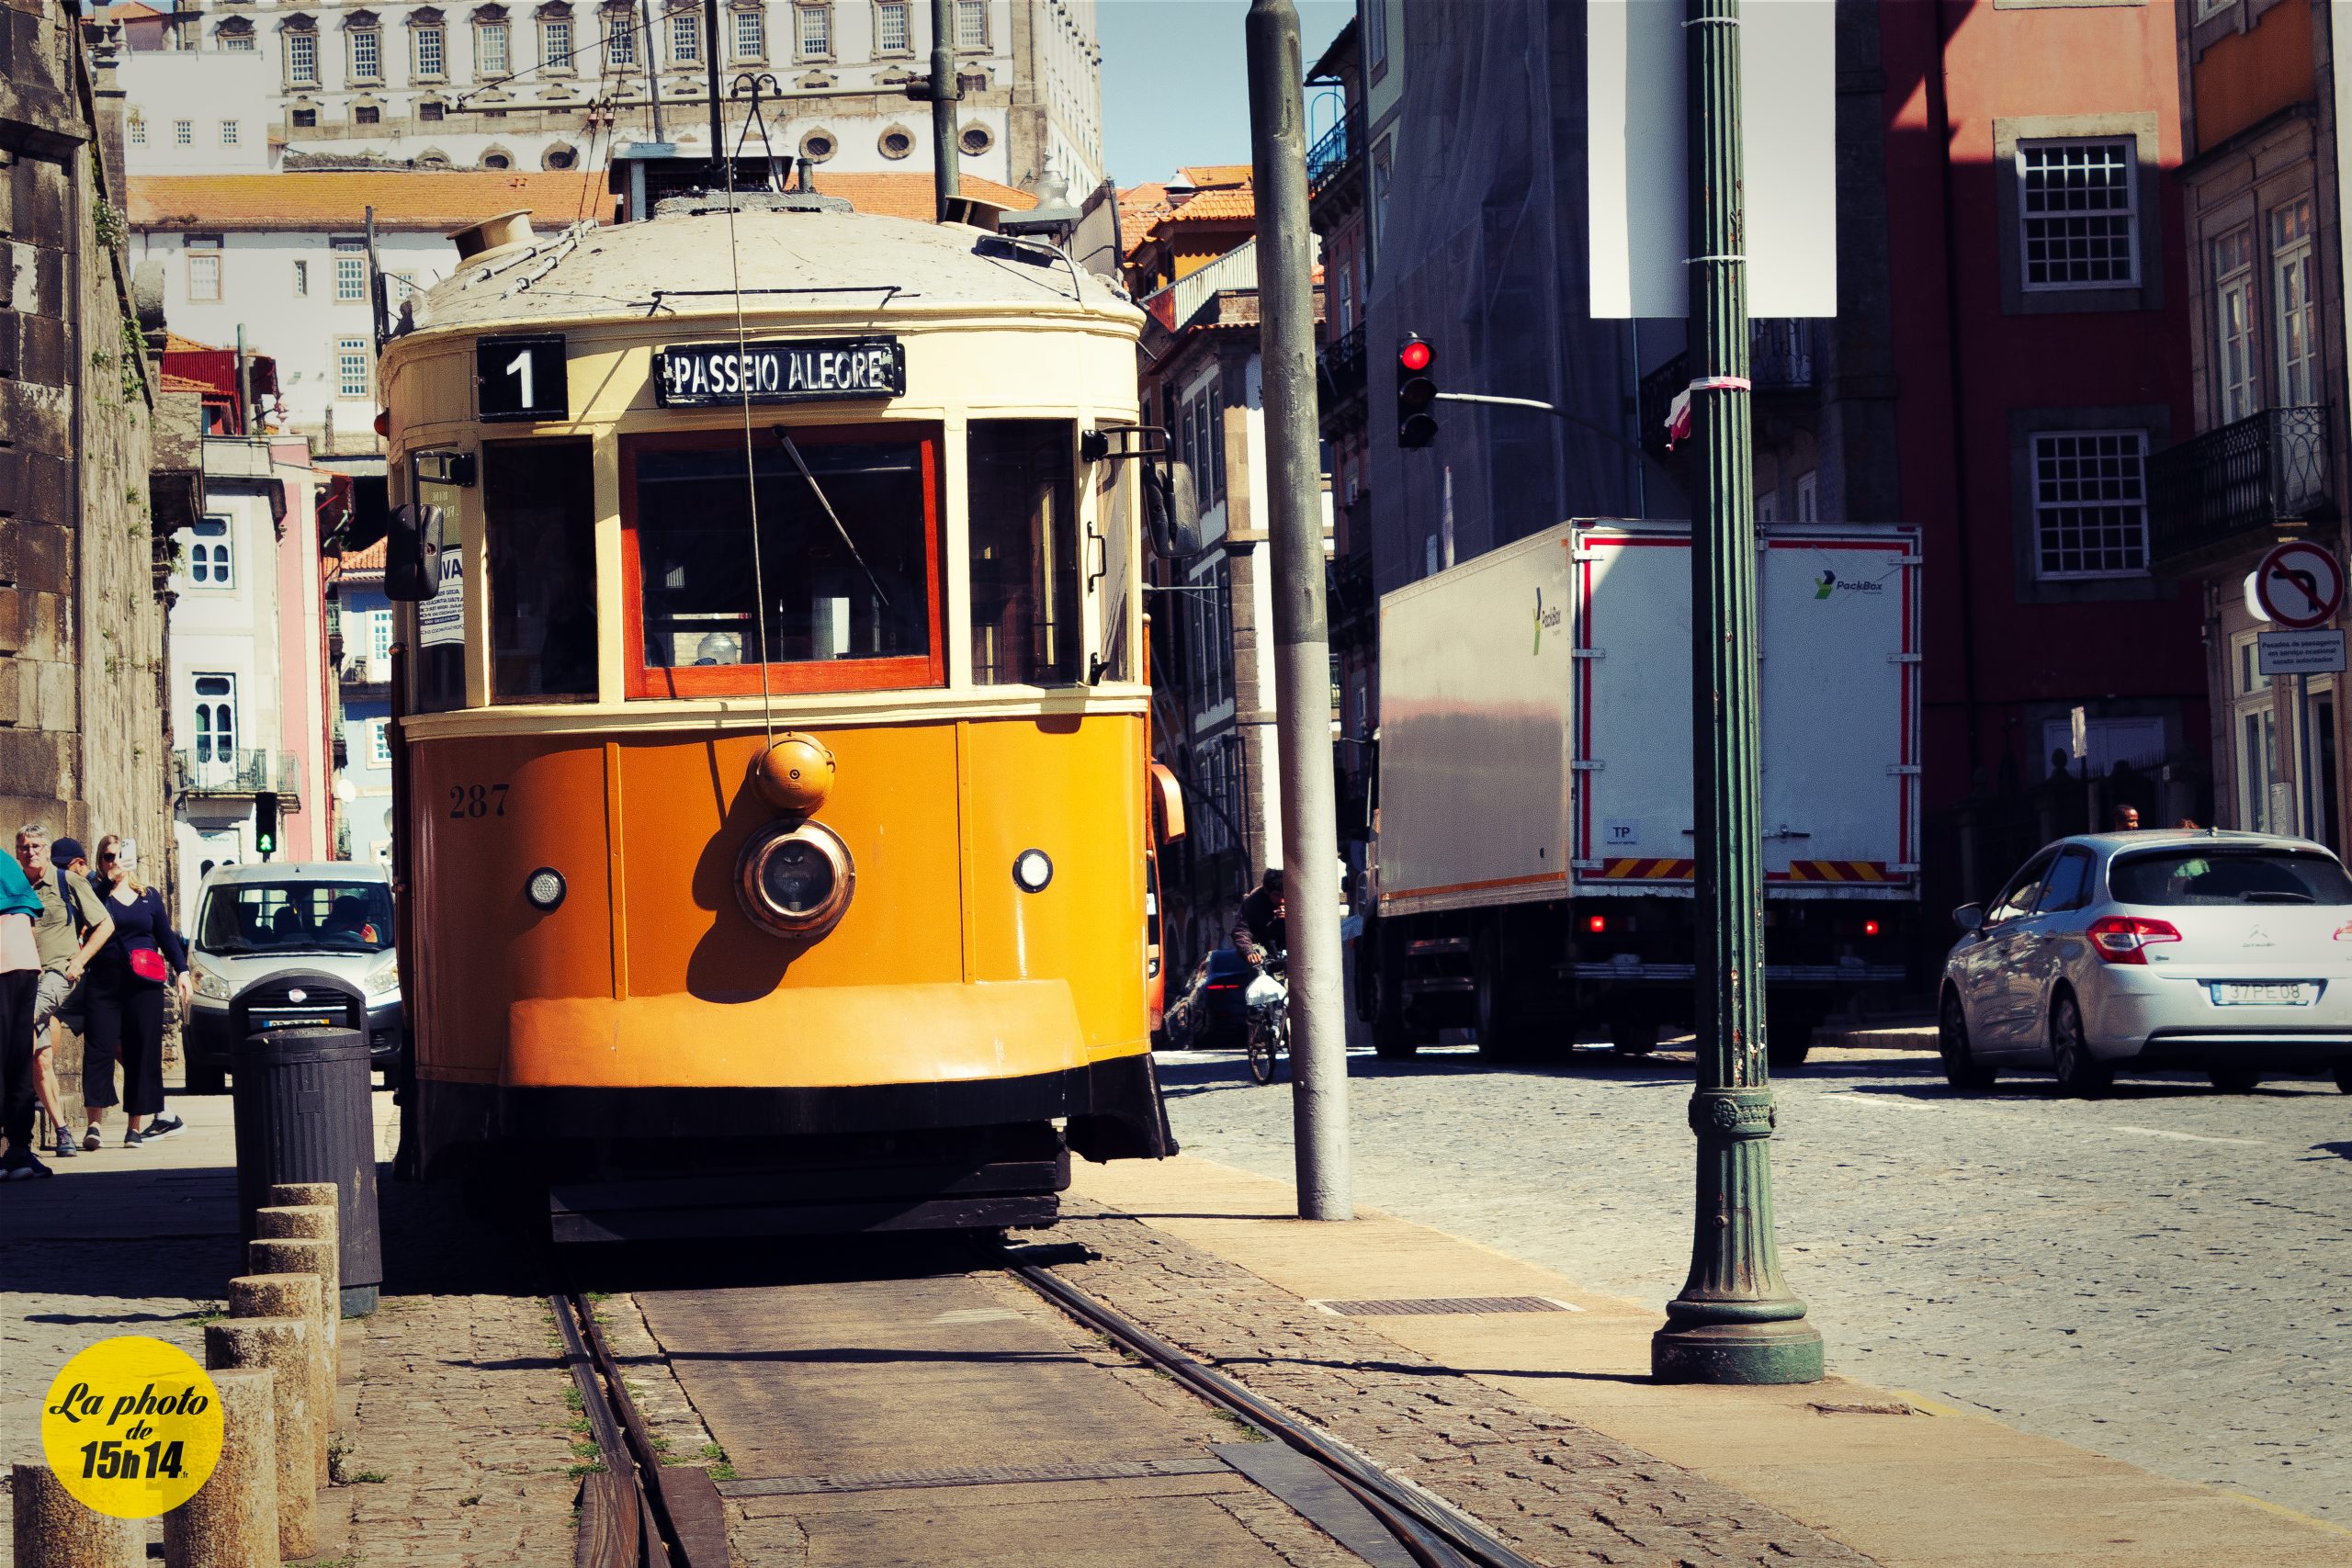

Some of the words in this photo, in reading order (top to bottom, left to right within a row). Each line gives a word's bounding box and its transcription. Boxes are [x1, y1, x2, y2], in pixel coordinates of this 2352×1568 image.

[506, 349, 535, 409] 1
[673, 353, 778, 394] PASSEIO
[788, 350, 882, 390] ALEGRE
[1837, 580, 1883, 591] PackBox
[449, 783, 511, 819] 287
[1612, 827, 1631, 838] TP
